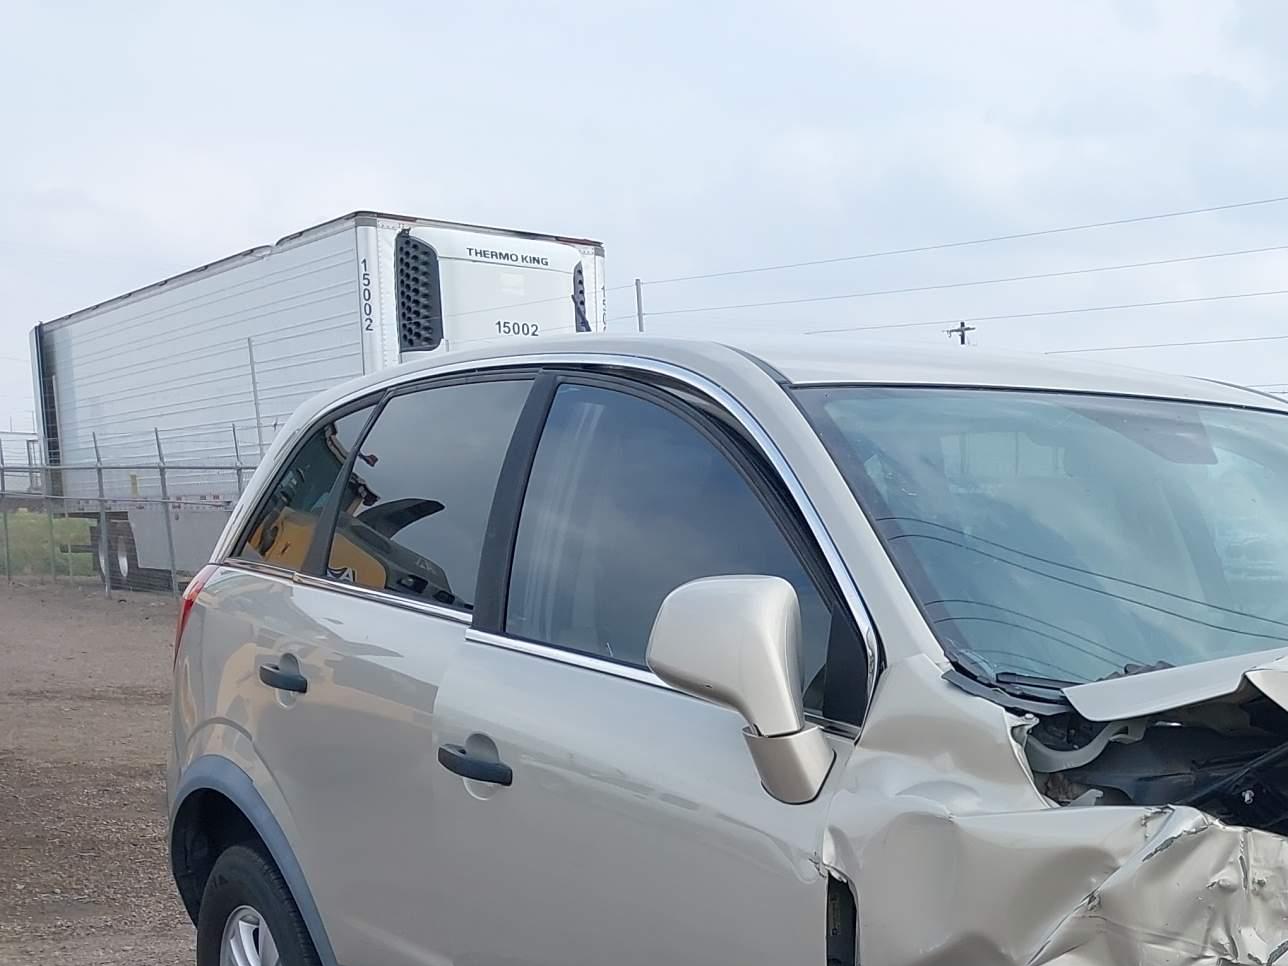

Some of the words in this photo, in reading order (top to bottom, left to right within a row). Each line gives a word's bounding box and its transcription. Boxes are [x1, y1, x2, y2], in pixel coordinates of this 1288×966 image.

[466, 247, 519, 263] THERMO
[521, 254, 549, 266] KING
[361, 258, 374, 331] 15002
[495, 320, 539, 337] 15002
